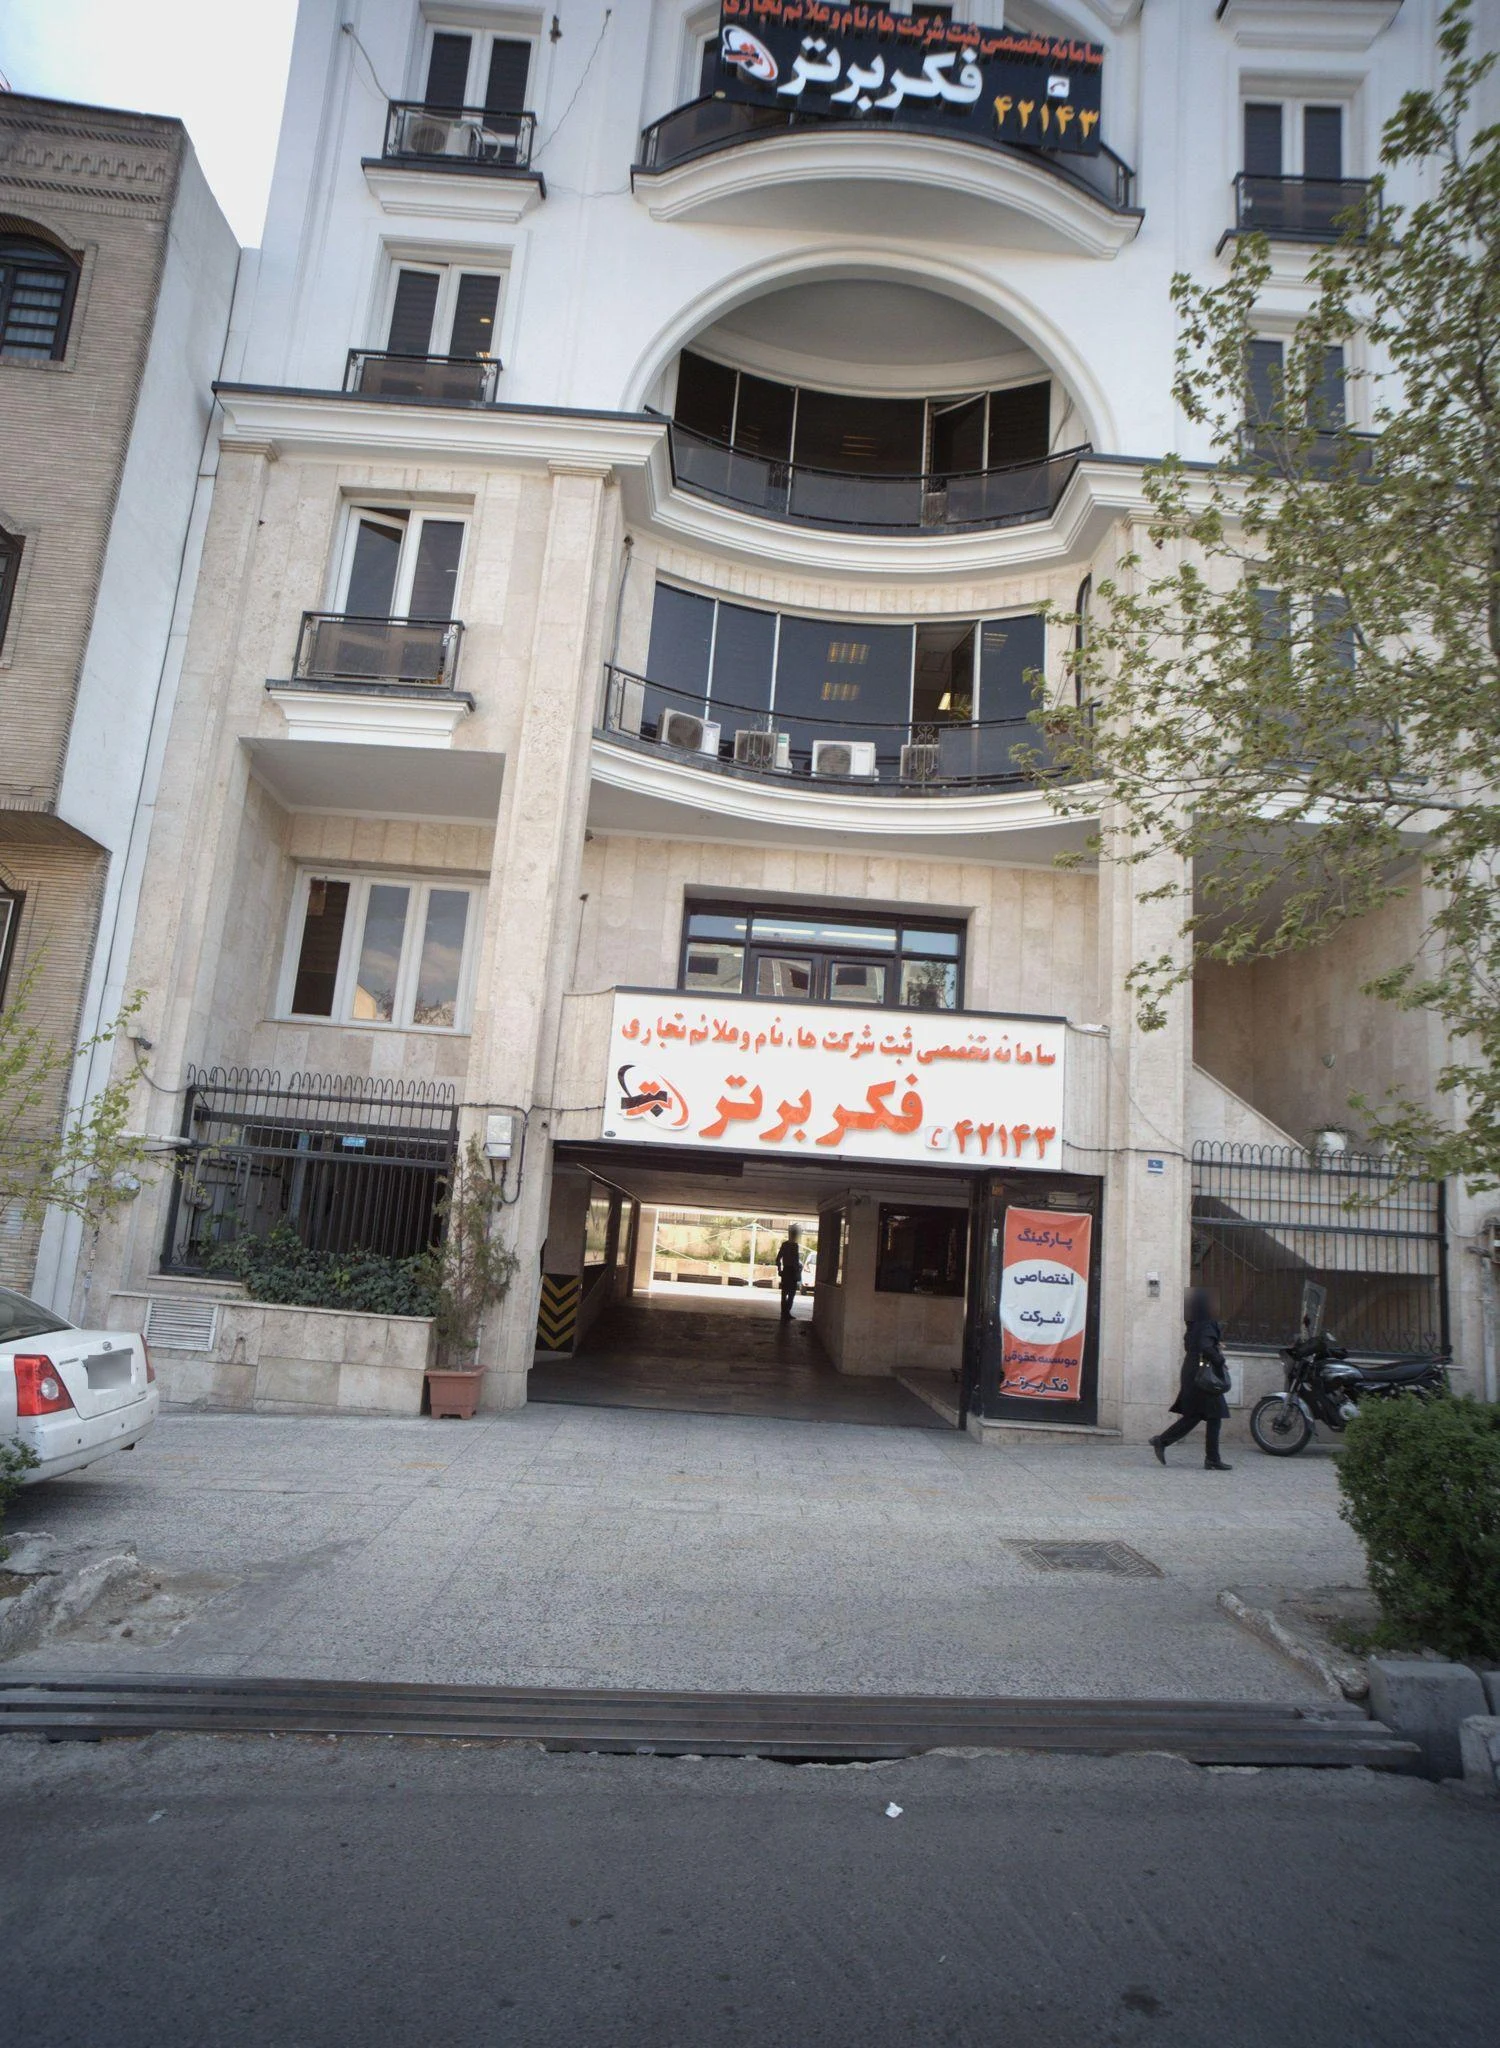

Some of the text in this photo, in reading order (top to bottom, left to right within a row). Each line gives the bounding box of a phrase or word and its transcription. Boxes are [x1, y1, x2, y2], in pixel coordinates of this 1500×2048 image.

[830, 11, 841, 30] و
[841, 4, 869, 36] نام
[896, 14, 946, 45] شرکت
[946, 21, 981, 51] ثبت
[980, 31, 1050, 56] تخصصی
[1051, 35, 1104, 64] سامانه
[777, 36, 885, 110] برتر
[874, 48, 983, 109] فکر
[994, 96, 1100, 138] ۴۲۱۴۳
[622, 1012, 687, 1048] تجاری
[690, 1014, 740, 1045] علائم
[740, 1030, 750, 1051] و
[755, 1017, 784, 1054] نام
[822, 1024, 875, 1059] شرکت
[880, 1026, 913, 1064] ثبت
[917, 1033, 990, 1065] تخصصی
[994, 1034, 1056, 1065] سامانه
[699, 1074, 812, 1141] برتر
[815, 1073, 923, 1147] فکر
[954, 1119, 1056, 1159] ۴۲۱۴۳
[1017, 1228, 1073, 1251] پارکینگ
[1014, 1270, 1074, 1286] اختصاصی
[1020, 1310, 1065, 1326] شرکت
[1004, 1350, 1037, 1363] حقوقی
